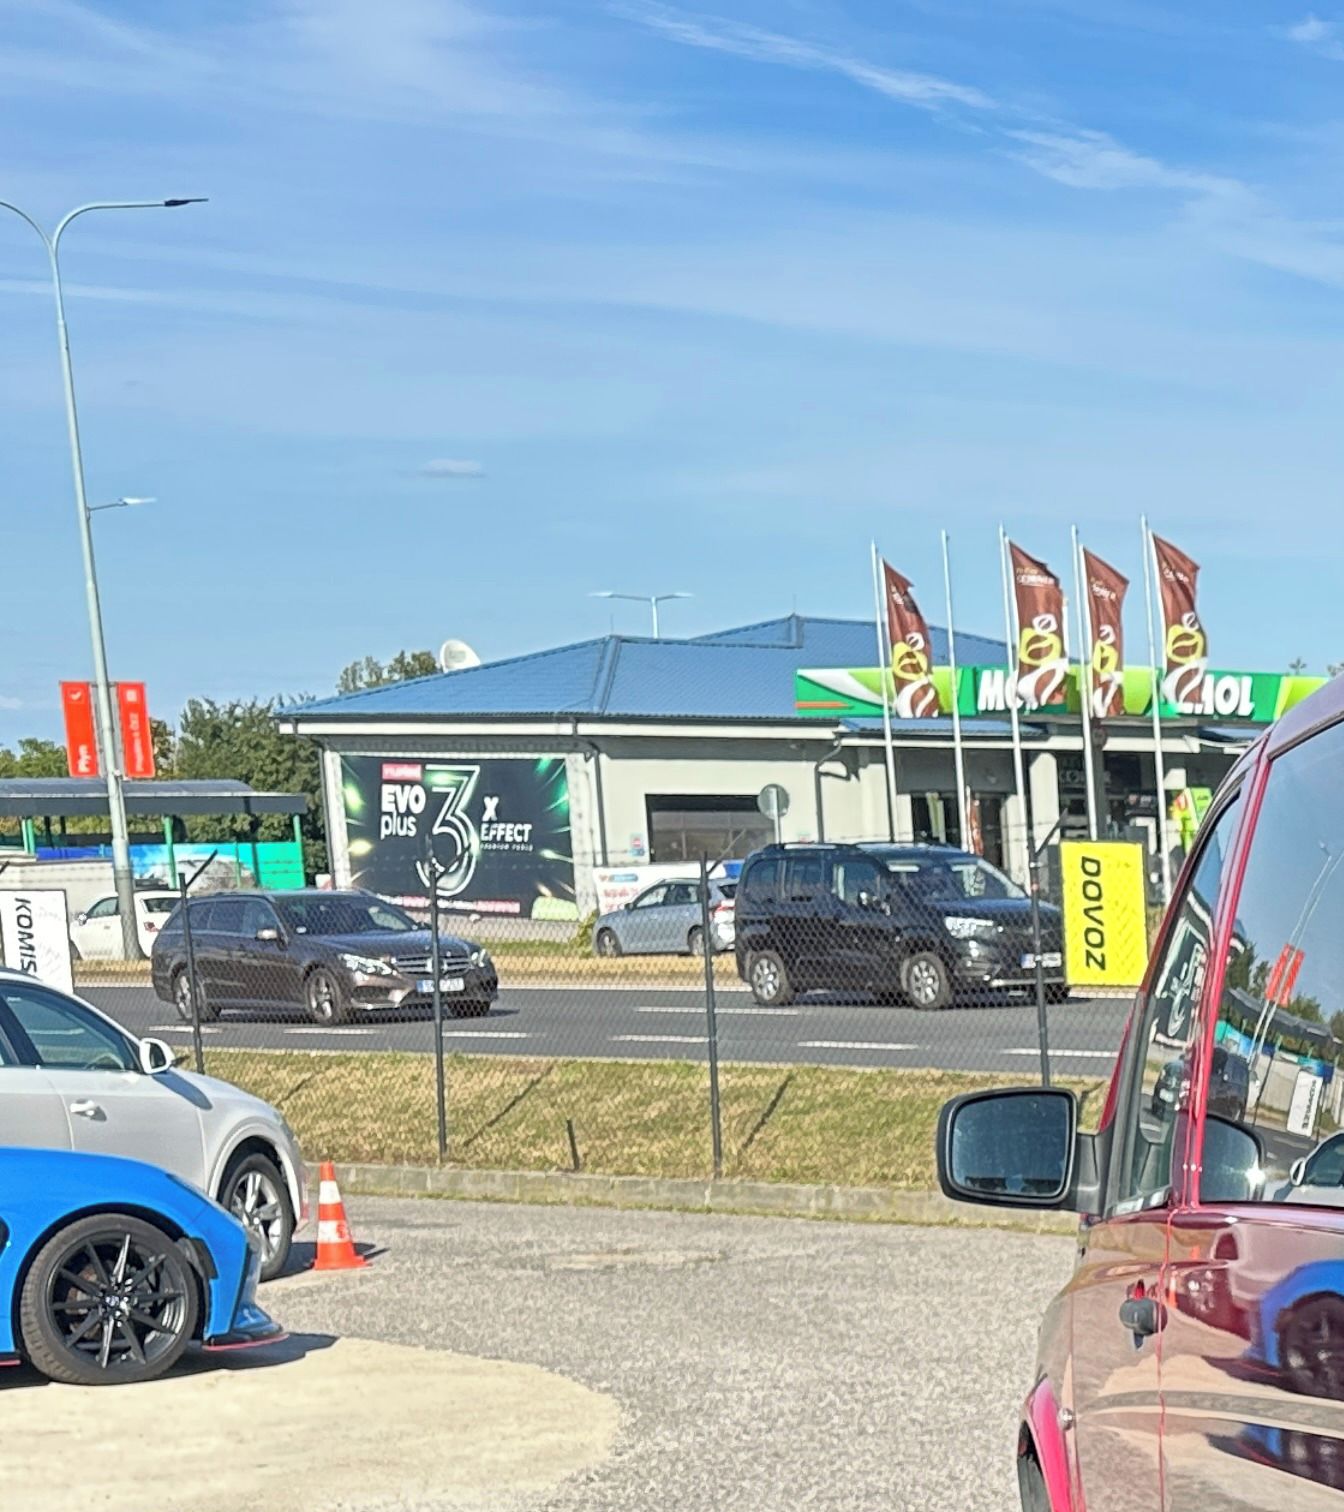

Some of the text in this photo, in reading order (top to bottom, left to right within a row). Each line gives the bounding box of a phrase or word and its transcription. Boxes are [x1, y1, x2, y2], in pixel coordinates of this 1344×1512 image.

[380, 811, 418, 840] plus
[381, 784, 426, 814] EVO
[416, 764, 480, 897] 3
[480, 823, 533, 842] EFFECT
[14, 897, 37, 974] KOMIS
[1081, 855, 1106, 971] DOVOZ
